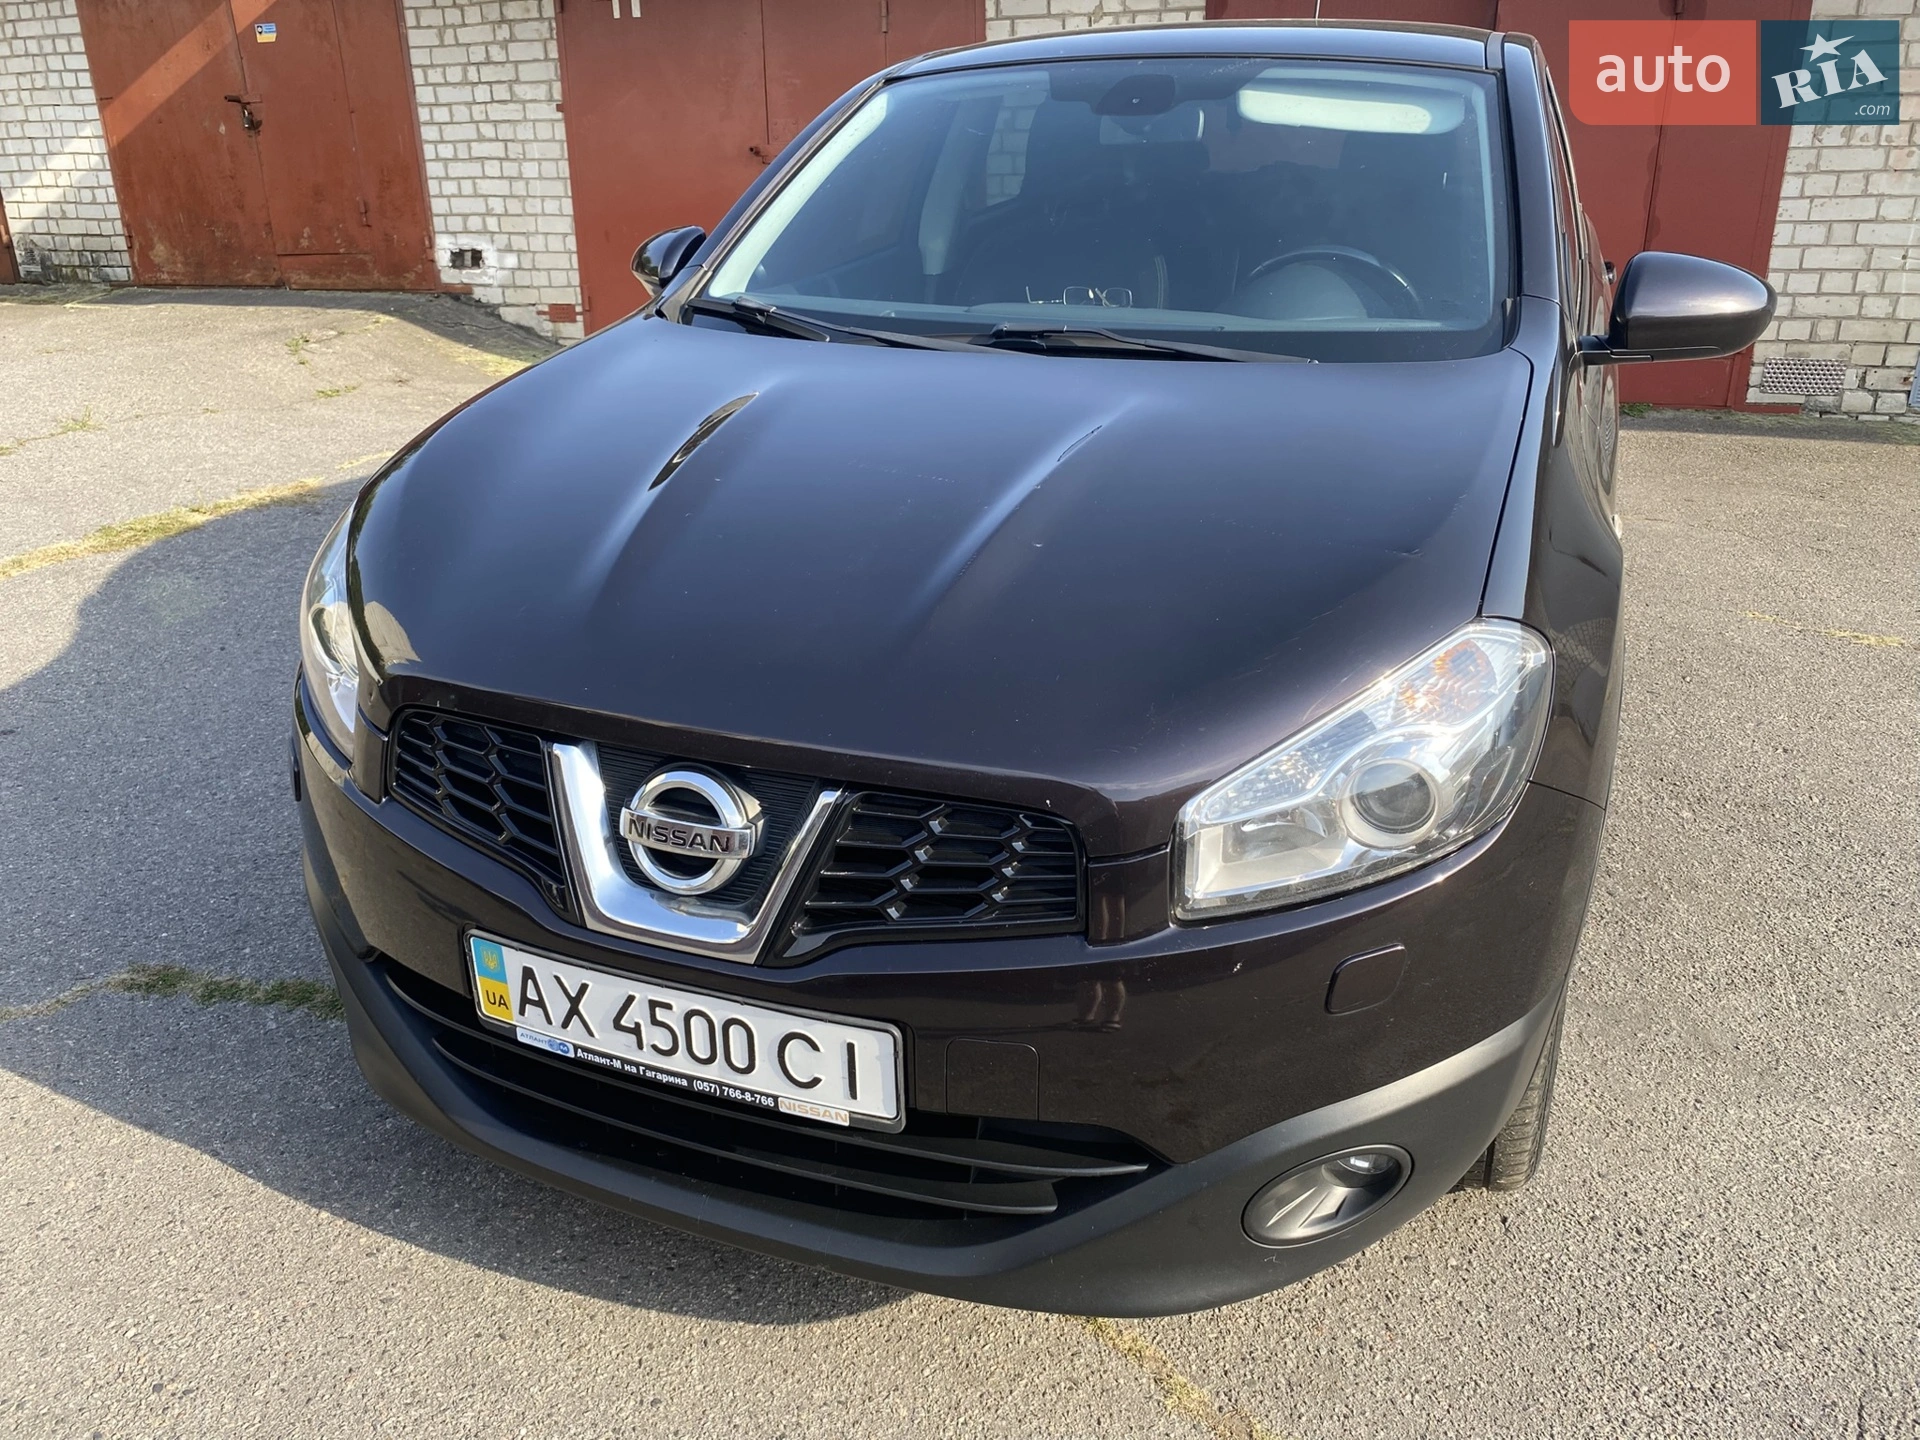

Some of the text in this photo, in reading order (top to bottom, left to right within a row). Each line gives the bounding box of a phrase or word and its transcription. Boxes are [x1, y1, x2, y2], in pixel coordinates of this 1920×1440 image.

[628, 818, 730, 854] NISSAN
[486, 990, 509, 1010] UA
[518, 965, 858, 1101] AX 4500 CI
[576, 1048, 775, 1108] Атлант-М на Гагарина (057) 766-8-766
[779, 1099, 849, 1123] NISSAN
